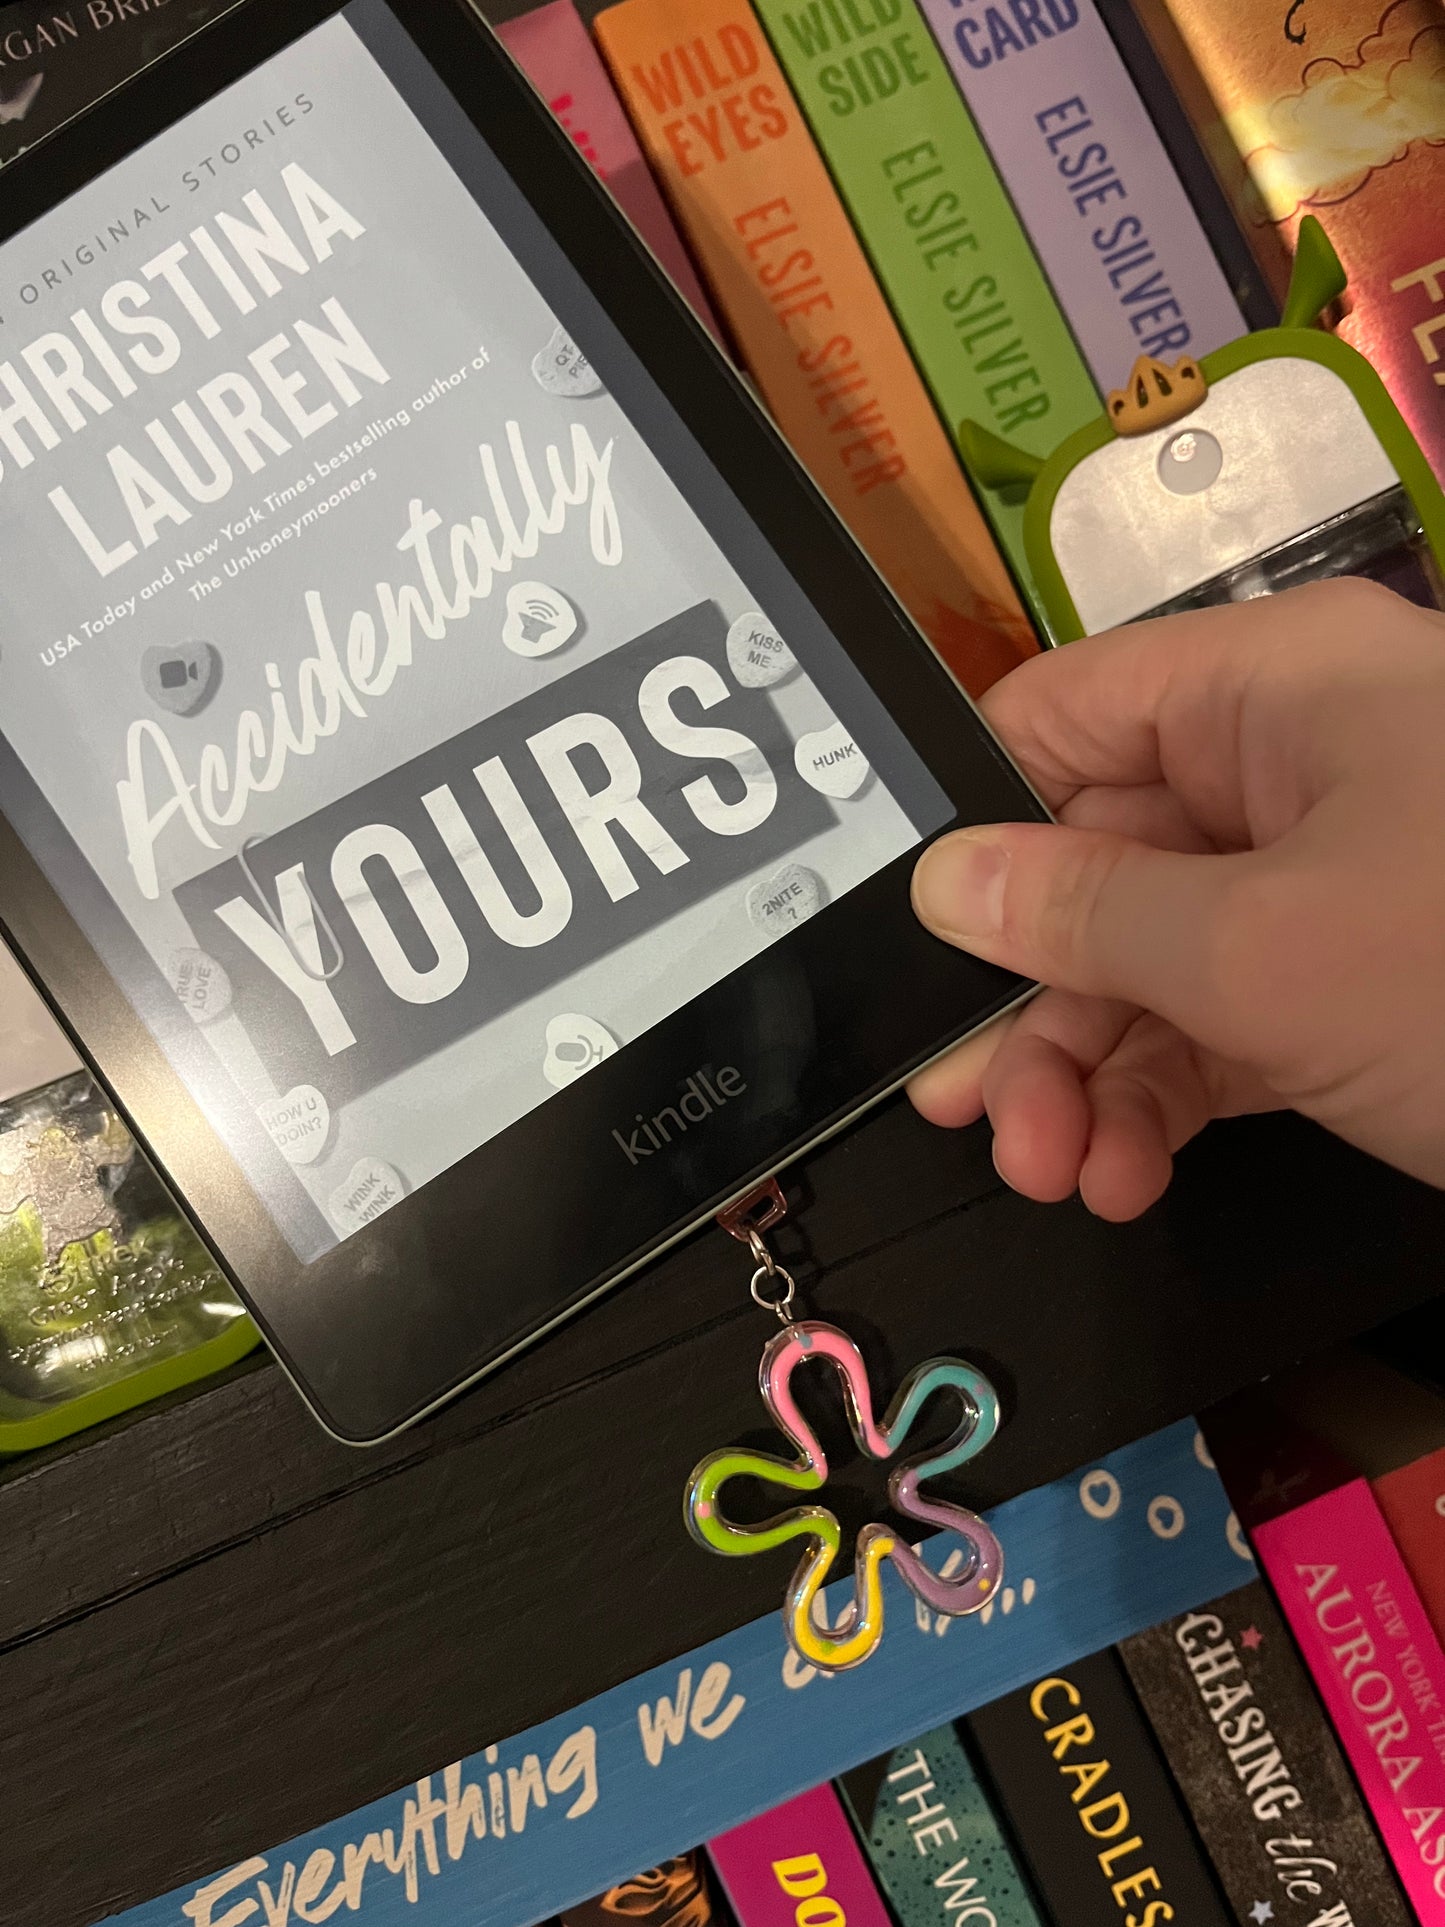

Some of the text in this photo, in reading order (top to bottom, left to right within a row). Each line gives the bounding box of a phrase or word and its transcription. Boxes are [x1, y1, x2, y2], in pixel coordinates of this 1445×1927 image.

[0, 11, 78, 66] GAN
[631, 23, 760, 114] WILD
[818, 32, 930, 117] SIDE
[955, 0, 1080, 69] CARD
[663, 84, 788, 178] EYES
[19, 93, 314, 304] ORIGINAL STORIES
[1035, 95, 1191, 357] ELSIE SILVER
[0, 162, 367, 485] HRISTINA
[882, 140, 1050, 433] ELSIE SILVER
[733, 196, 907, 498] ELSIE SILVER
[47, 297, 392, 578] LAUREN
[40, 346, 491, 667] USA Today and New York Times bestselling author of
[188, 466, 379, 603] The Unhoneymooners
[116, 420, 624, 900] Accidentally
[747, 650, 771, 669] ME
[748, 630, 784, 653] KISS
[812, 743, 857, 771] HUNK
[214, 655, 778, 1057] YOURS
[762, 882, 803, 916] 2NITE
[177, 961, 193, 1001] RUE
[192, 967, 211, 1010] LOVE
[265, 1097, 318, 1131] HOW U
[275, 1116, 322, 1147] DOIN?
[611, 1066, 747, 1166] kindle
[344, 1172, 380, 1213] WINK
[359, 1185, 395, 1223] WINK
[1296, 1564, 1423, 1794] AURORA
[1366, 1579, 1410, 1638] NEW
[1396, 1644, 1441, 1714] YORK
[182, 1661, 746, 1927] Everything we
[887, 1749, 959, 1856] THE
[1030, 1677, 1175, 1927] CRADLES
[1175, 1612, 1303, 1822] CHASING
[1265, 1832, 1337, 1903] the
